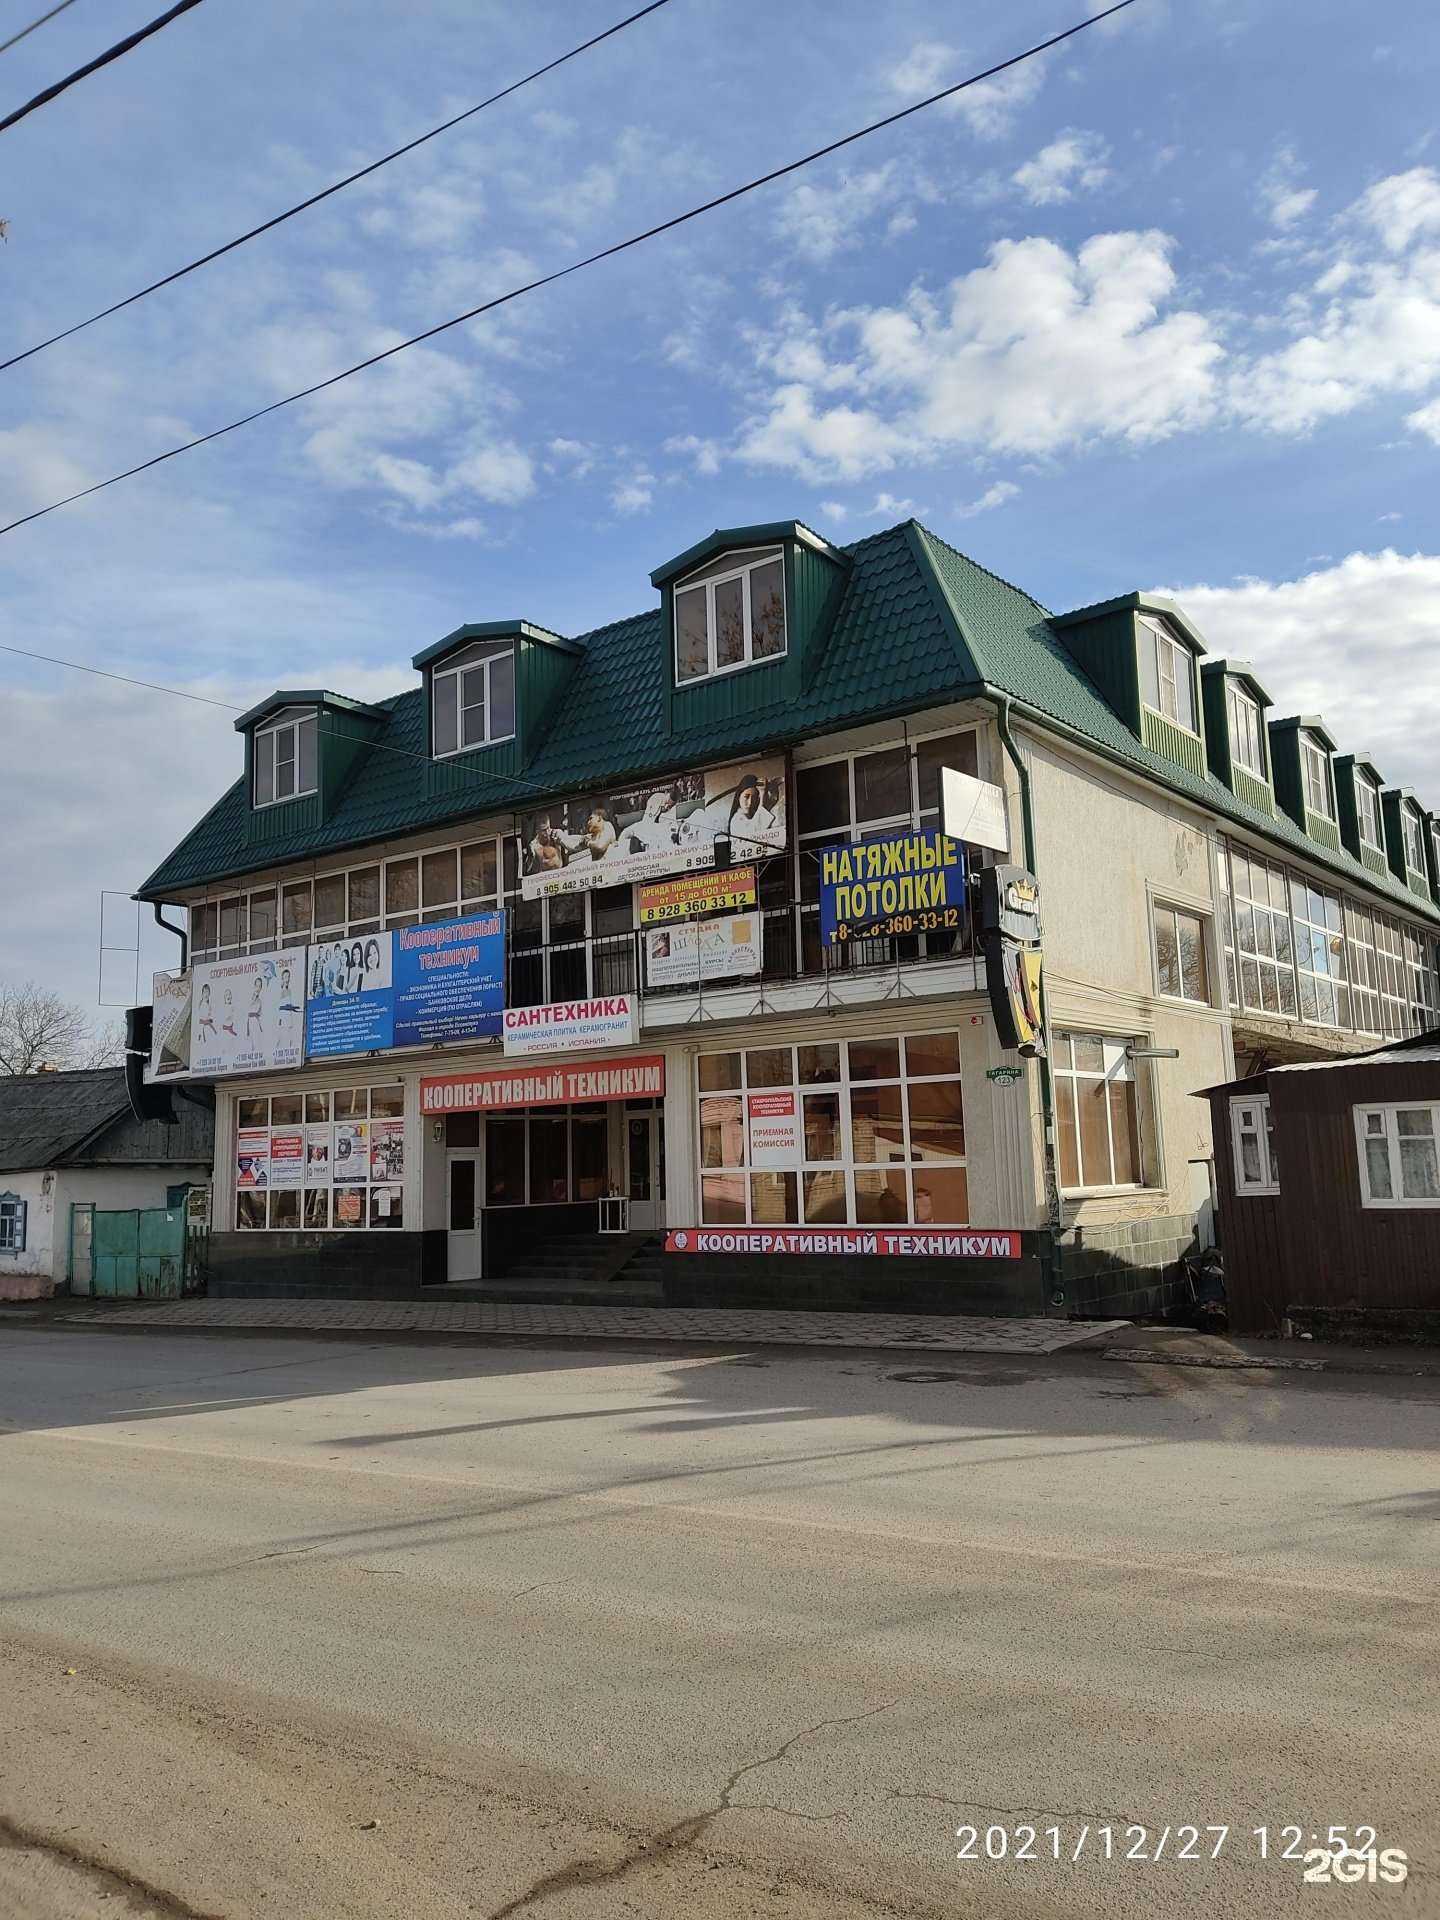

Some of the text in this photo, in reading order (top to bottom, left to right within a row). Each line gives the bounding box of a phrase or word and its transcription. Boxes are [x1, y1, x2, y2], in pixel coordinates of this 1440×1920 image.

[686, 855, 714, 867] 8 909
[740, 848, 753, 858] 42
[823, 833, 958, 886] НАТЯЖНЫЕ
[544, 884, 559, 895] 905
[562, 880, 577, 891] 442
[642, 886, 670, 897] АРЕНДА
[728, 870, 752, 881] КАФЕ
[675, 893, 686, 901] 15
[702, 886, 719, 896] 600
[836, 870, 947, 920] ПОТОЛКИ
[647, 893, 747, 920] 8 928 360 33 12
[399, 911, 501, 950] Кооперативный
[418, 945, 480, 970] техникум
[505, 997, 629, 1029] САНТЕХНИКА
[507, 1020, 628, 1042] КЕРАМИЧЕСКАЯ ПЛИТКА КЕРАМОГРАНИТ
[423, 1066, 661, 1110] КООПЕРАТИВНЫЙ ТЕХНИКУМ
[752, 1128, 794, 1137] ПРИЕМНАЯ
[752, 1139, 795, 1149] КОМИССИЯ
[697, 1231, 1011, 1256] КООПЕРАТИВНЫЙ ТЕХНИКУМ
